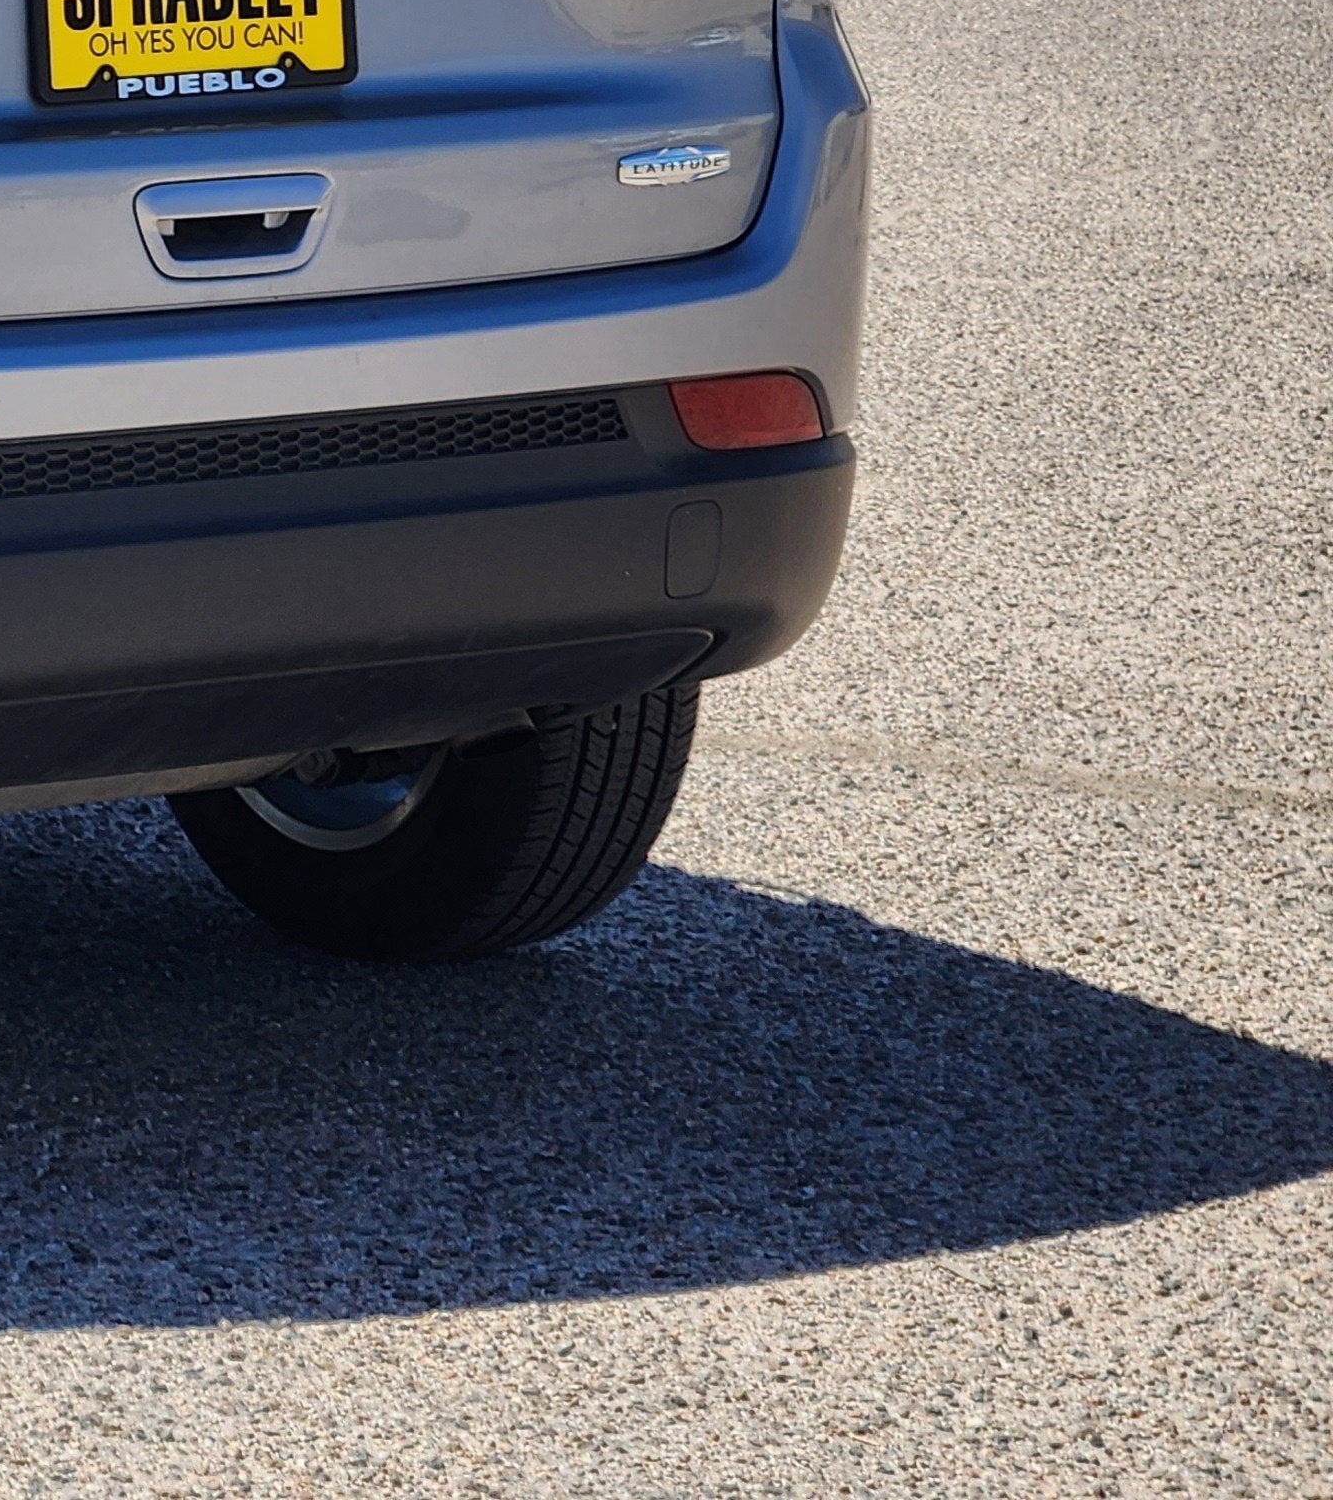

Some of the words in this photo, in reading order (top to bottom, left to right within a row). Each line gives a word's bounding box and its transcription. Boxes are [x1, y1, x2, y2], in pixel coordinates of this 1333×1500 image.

[88, 31, 128, 58] OH
[133, 27, 176, 55] YES
[181, 25, 235, 52] YOU
[243, 21, 305, 48] CAN!
[117, 66, 287, 100] PUEBLO
[632, 156, 728, 175] LATITUDE
